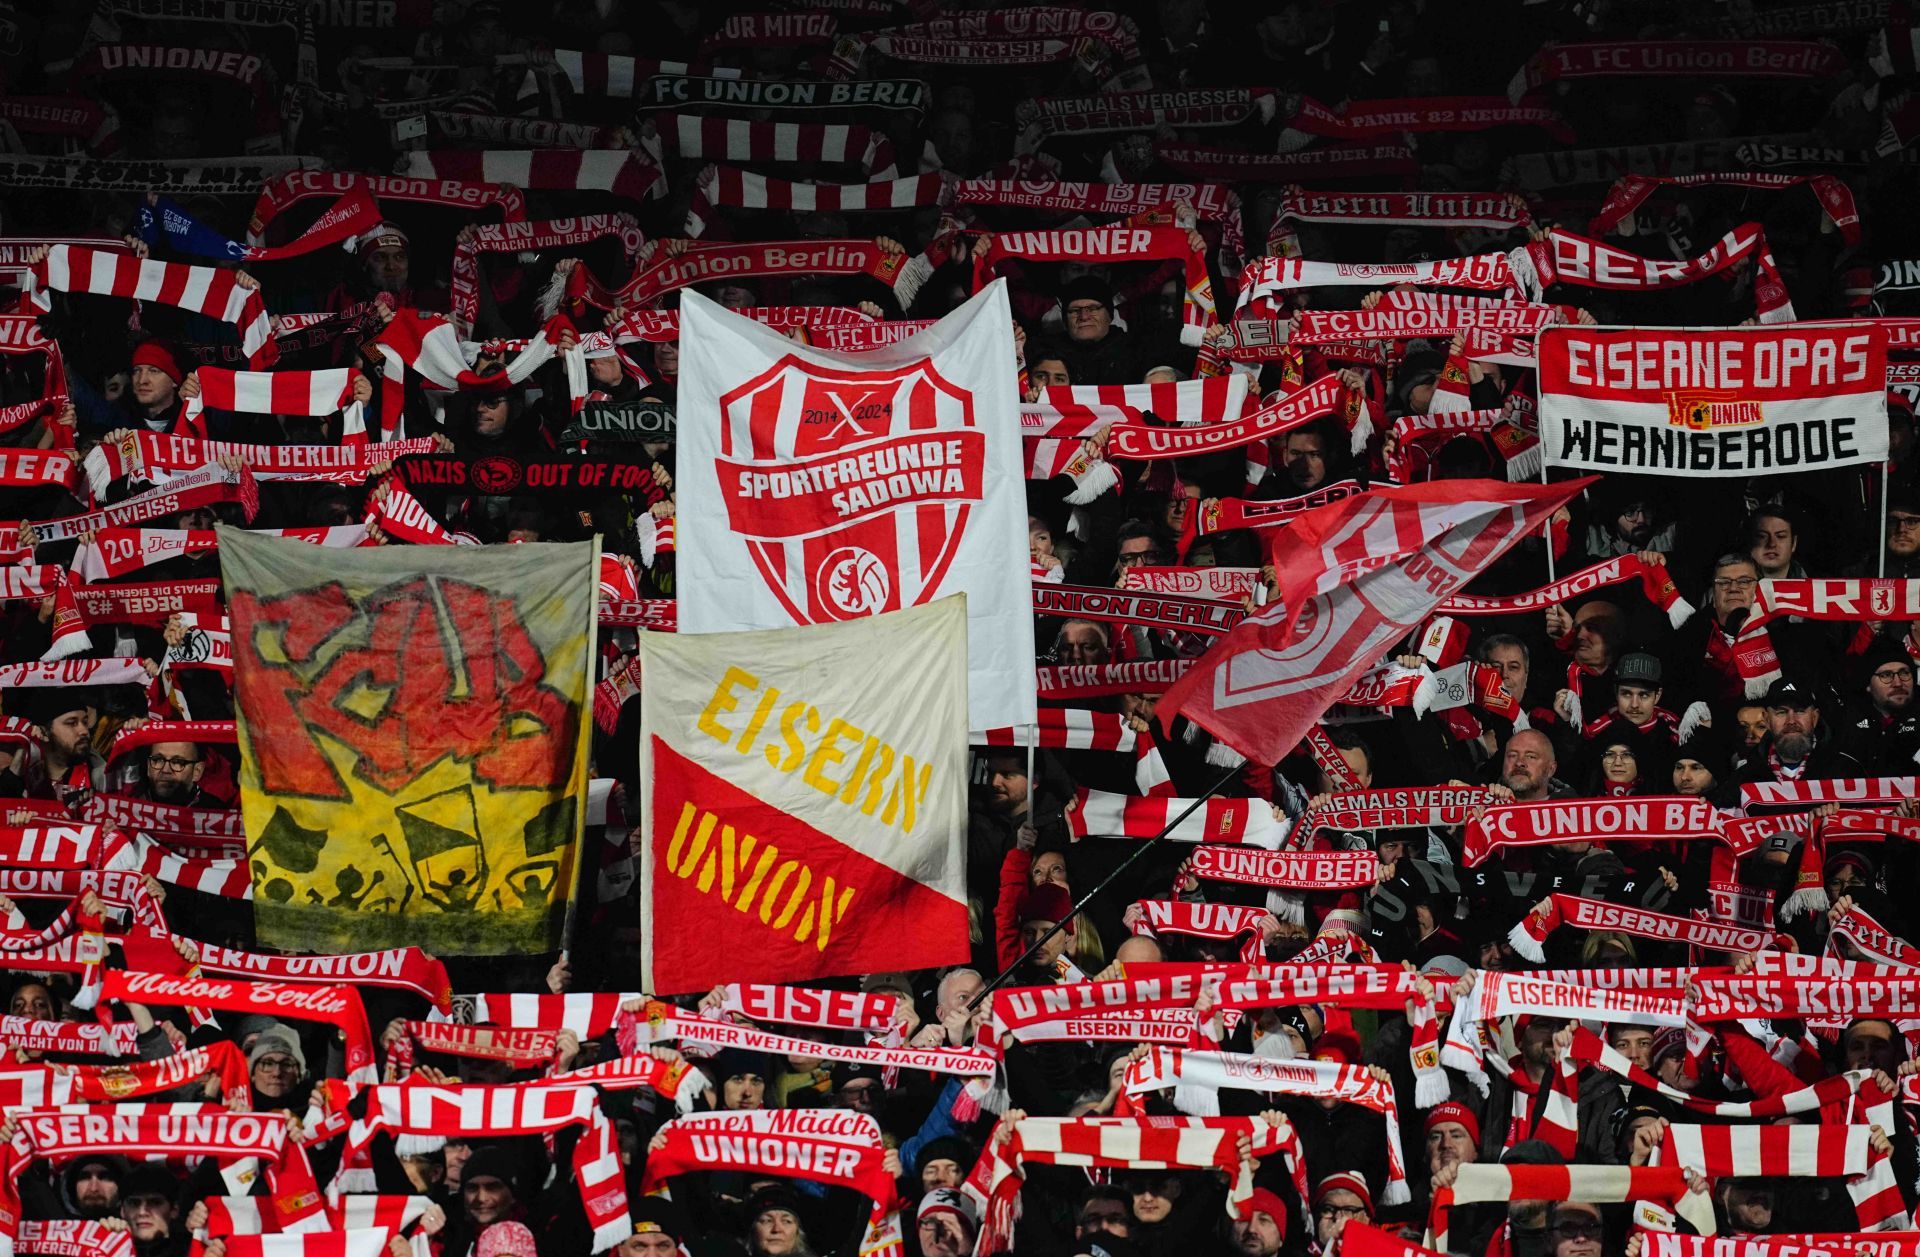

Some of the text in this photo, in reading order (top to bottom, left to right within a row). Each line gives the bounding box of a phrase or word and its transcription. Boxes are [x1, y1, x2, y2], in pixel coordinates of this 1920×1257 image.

[99, 46, 263, 84] UNIONER
[1592, 48, 1631, 69] FC
[1641, 47, 1734, 69] Union
[656, 79, 689, 103] FC
[704, 80, 816, 104] UNION
[1042, 89, 1251, 116] NIEMALS VERGESSEN
[437, 112, 601, 150] UNION
[1351, 112, 1420, 128] PANIK
[1329, 148, 1370, 163] DER
[284, 171, 322, 191] FC
[999, 193, 1041, 206] UNSER
[1044, 196, 1086, 210] STOLZ
[1405, 194, 1519, 220] Union
[491, 231, 589, 253] MACHT VON DER
[999, 230, 1152, 256] UNIONER
[656, 254, 752, 287] Union
[764, 244, 866, 270] Berlin
[1431, 252, 1510, 286] 1966
[1311, 313, 1352, 335] FC
[1355, 309, 1449, 331] UNION
[1567, 334, 1870, 390] EISERNE OPAS
[804, 409, 838, 426] 2014
[856, 403, 892, 422] 2024
[1711, 403, 1761, 426] UNION
[148, 433, 166, 464] 1.
[170, 436, 197, 466] FC
[277, 444, 356, 467] BERLIN
[1147, 424, 1245, 452] Union
[1561, 416, 1859, 471] WERNIGERODE
[364, 450, 389, 466] 2019
[738, 440, 962, 499] SPORTFREUNDE
[162, 471, 211, 493] Union
[406, 458, 467, 485] NAZIS
[526, 463, 572, 488] OUT
[578, 463, 606, 487] OF
[832, 468, 965, 517] SADOWA
[108, 495, 180, 527] WEISS
[61, 514, 103, 538] ROT
[104, 538, 144, 566] 20.
[109, 585, 150, 600] EIGENE
[152, 584, 171, 597] DIE
[1126, 571, 1203, 593] SIND
[1512, 560, 1622, 607] UNION
[86, 595, 184, 616] REGEL #3
[1032, 590, 1133, 616] UNION
[1624, 659, 1654, 675] BERLIN
[697, 664, 934, 834] EISERN
[1314, 807, 1429, 830] EISERN
[1481, 810, 1518, 844] FC
[1533, 802, 1649, 836] UNION
[1739, 819, 1775, 843] FC
[1218, 851, 1308, 882] UNION
[1276, 851, 1292, 860] AN
[1294, 852, 1341, 861] SCHULTER
[665, 800, 856, 953] UNION
[1256, 876, 1327, 888] EISERN UNION
[1716, 882, 1757, 895] STADION
[1576, 900, 1680, 938] EISERN
[285, 947, 408, 978] UNION
[122, 970, 348, 1014] Union Berlin
[1506, 981, 1684, 1016] EISERNE HEIMAT
[9, 1034, 84, 1051] MACHT VON
[1066, 1022, 1131, 1038] EISERN
[676, 1023, 740, 1045] IMMER
[744, 1033, 823, 1056] WEITER
[827, 1046, 881, 1063] GANZ
[885, 1050, 939, 1068] NACH
[943, 1057, 995, 1073] VORN
[1273, 1065, 1317, 1082] UNION
[12, 1115, 288, 1156] EISERN UNION
[689, 1134, 862, 1179] UNIONER
[32, 1242, 82, 1256] VEREIN
